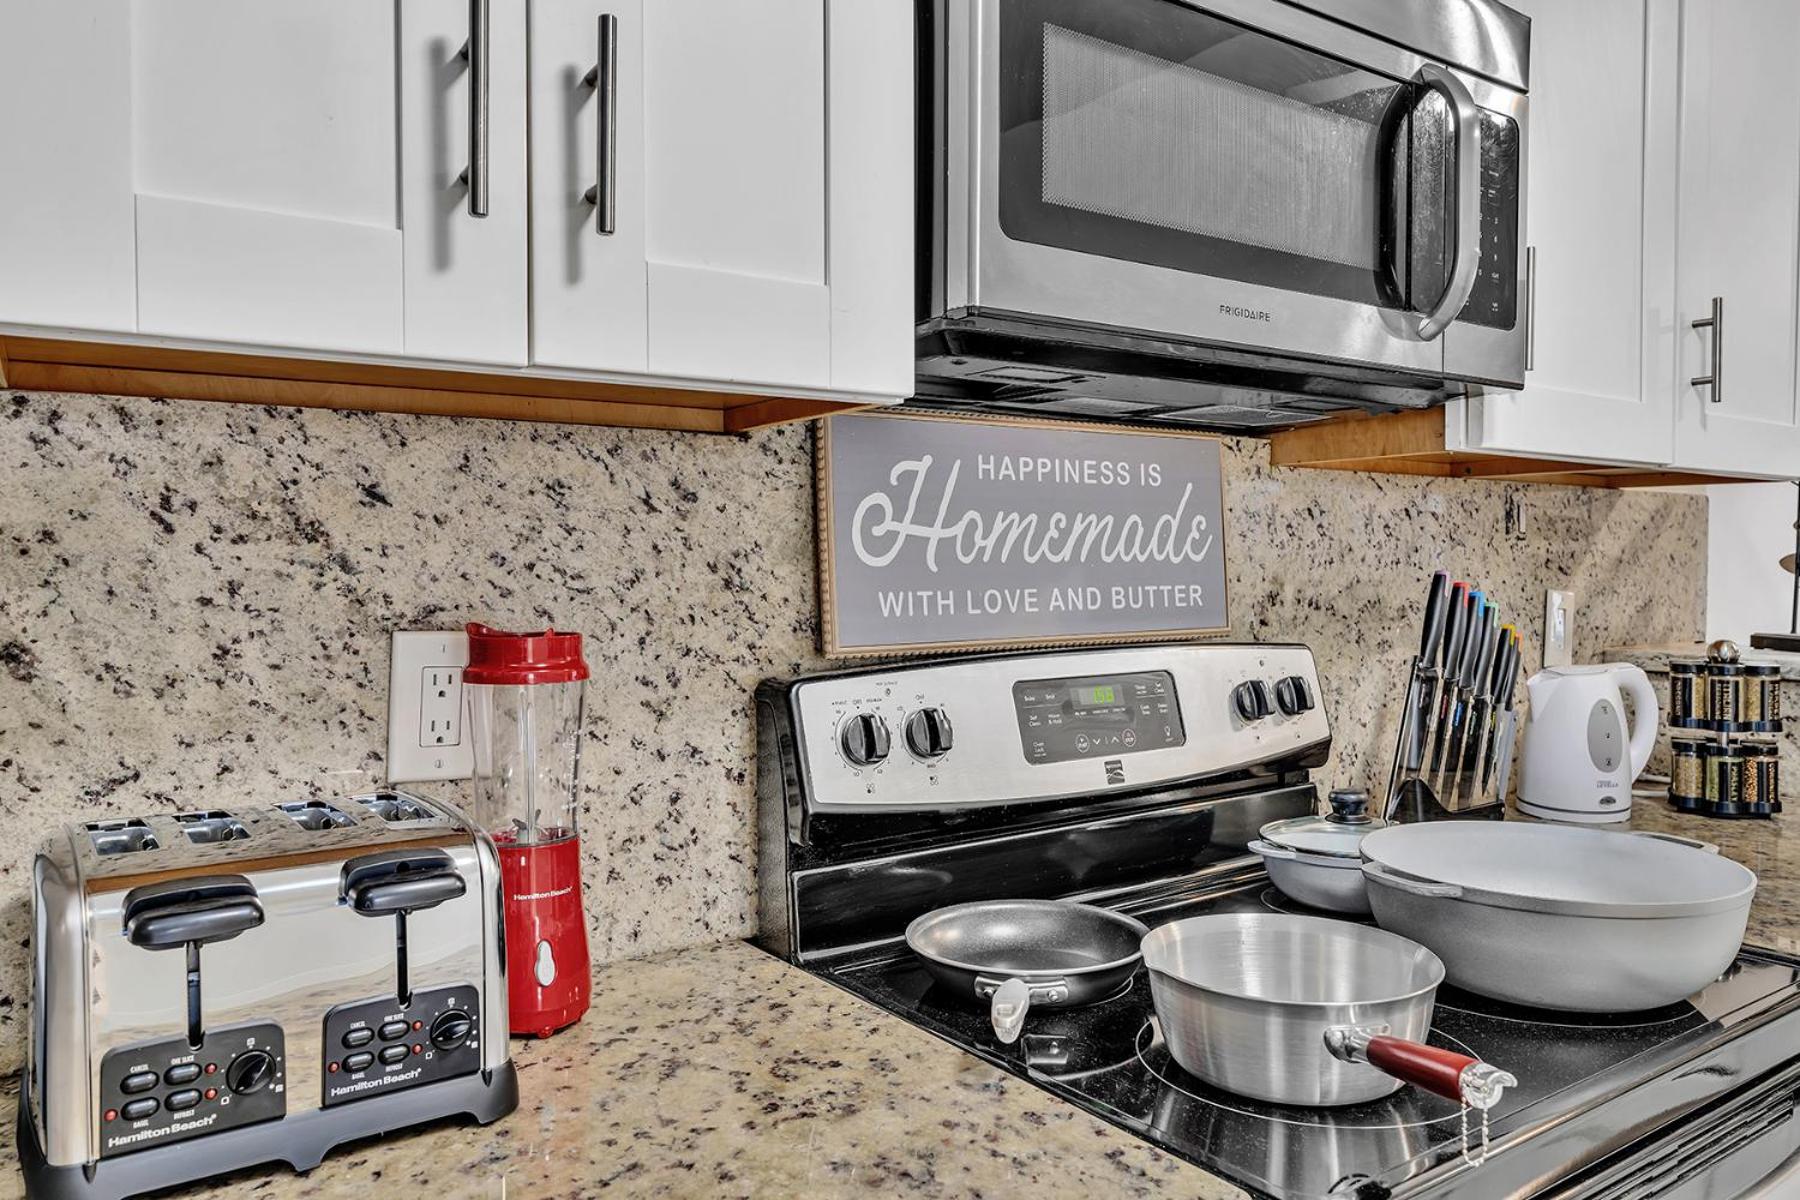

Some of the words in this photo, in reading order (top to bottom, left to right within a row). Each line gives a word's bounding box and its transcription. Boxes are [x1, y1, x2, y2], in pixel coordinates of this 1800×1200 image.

[1219, 304, 1271, 322] FRIGIDAIRE
[977, 454, 1131, 486] HAPPINESS
[1140, 463, 1162, 487] IS
[851, 454, 1213, 573] Homemade
[878, 591, 955, 617] WITH
[966, 588, 1039, 615] LOVE
[1049, 586, 1102, 612] AND
[1111, 584, 1204, 610] BUTTER
[513, 891, 551, 900] Hamilton
[130, 1063, 149, 1074] CANCEL
[330, 1078, 382, 1097] Hamilton
[383, 1070, 419, 1085] Beach
[108, 1123, 170, 1148] Hamilton
[171, 1116, 213, 1134] Beach
